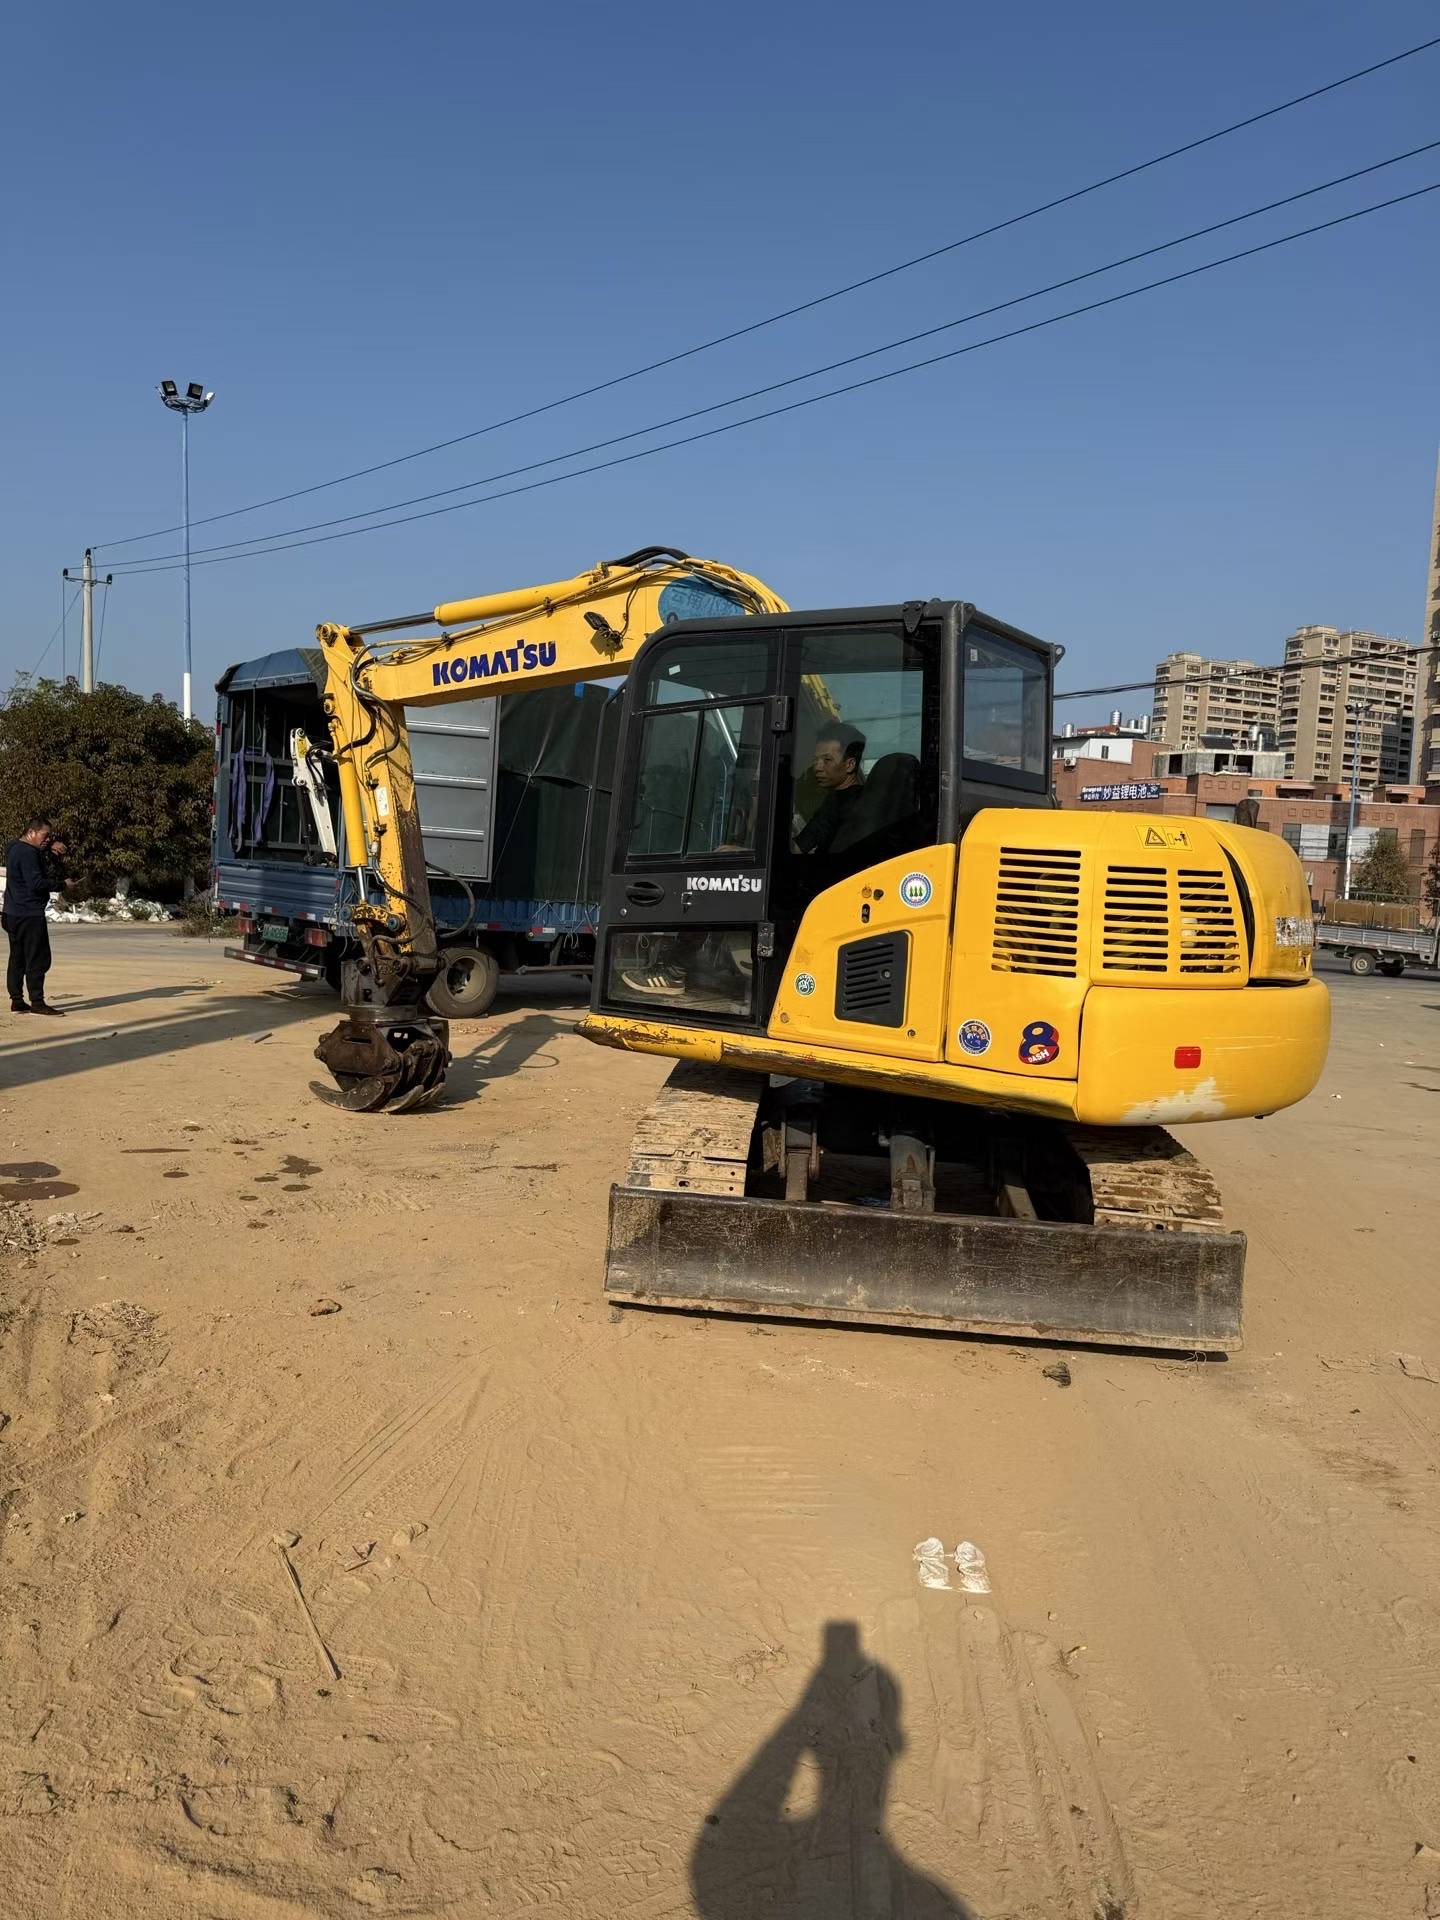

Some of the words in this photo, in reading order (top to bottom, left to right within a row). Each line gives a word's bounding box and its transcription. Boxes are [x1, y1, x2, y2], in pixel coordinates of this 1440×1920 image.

[432, 639, 557, 687] KOMATSU
[1102, 784, 1147, 800] 妙益锂电池
[686, 874, 762, 893] KOMATSU
[1018, 1021, 1060, 1065] 8
[1027, 1049, 1050, 1063] DASH
